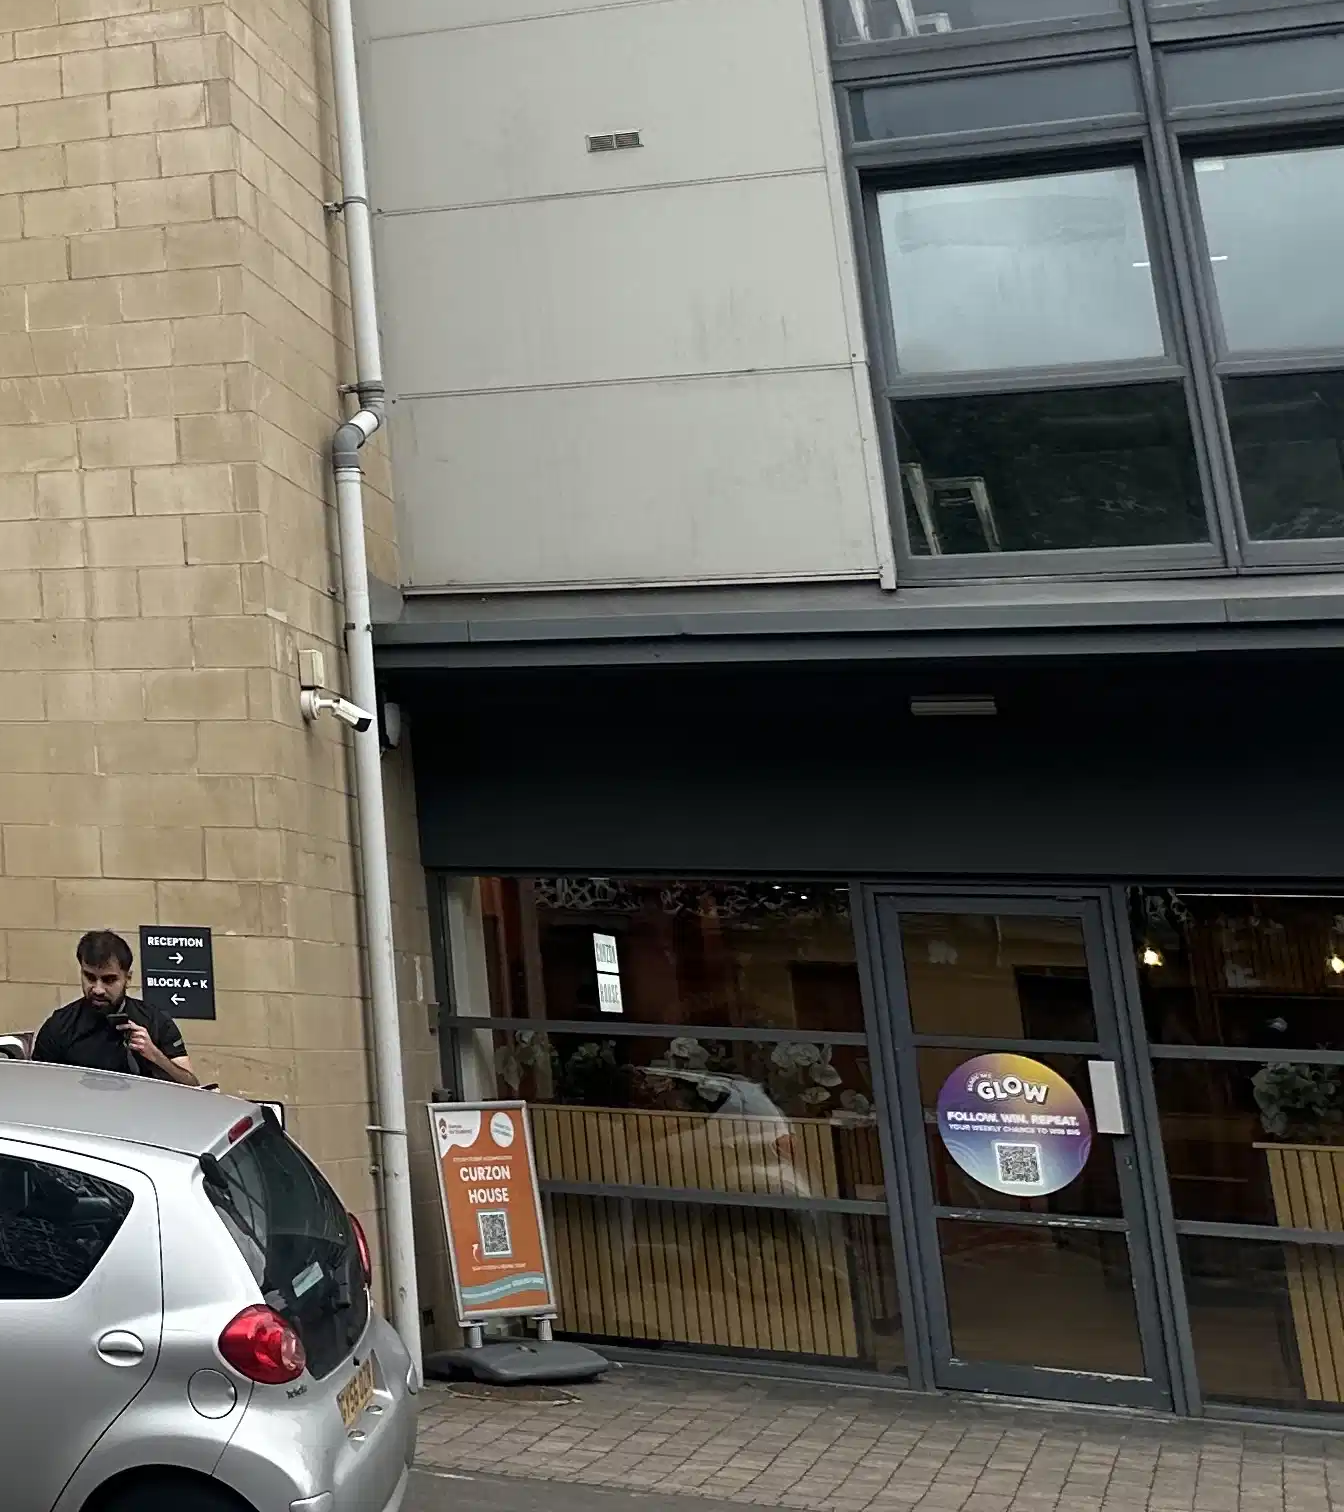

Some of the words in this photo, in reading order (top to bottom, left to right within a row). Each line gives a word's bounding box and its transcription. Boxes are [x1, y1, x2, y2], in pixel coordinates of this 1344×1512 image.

[147, 936, 204, 948] RECEPTION
[146, 977, 182, 988] BLOCK
[182, 978, 192, 988] A
[200, 979, 208, 989] K
[977, 1076, 1049, 1103] GLOW
[946, 1111, 999, 1123] FOLLOW.
[1000, 1113, 1029, 1125] WIN.
[1030, 1114, 1080, 1127] REPEAT.
[948, 1123, 971, 1131] YOUR
[459, 1165, 511, 1182] CURZON
[467, 1187, 510, 1204] HOUSE
